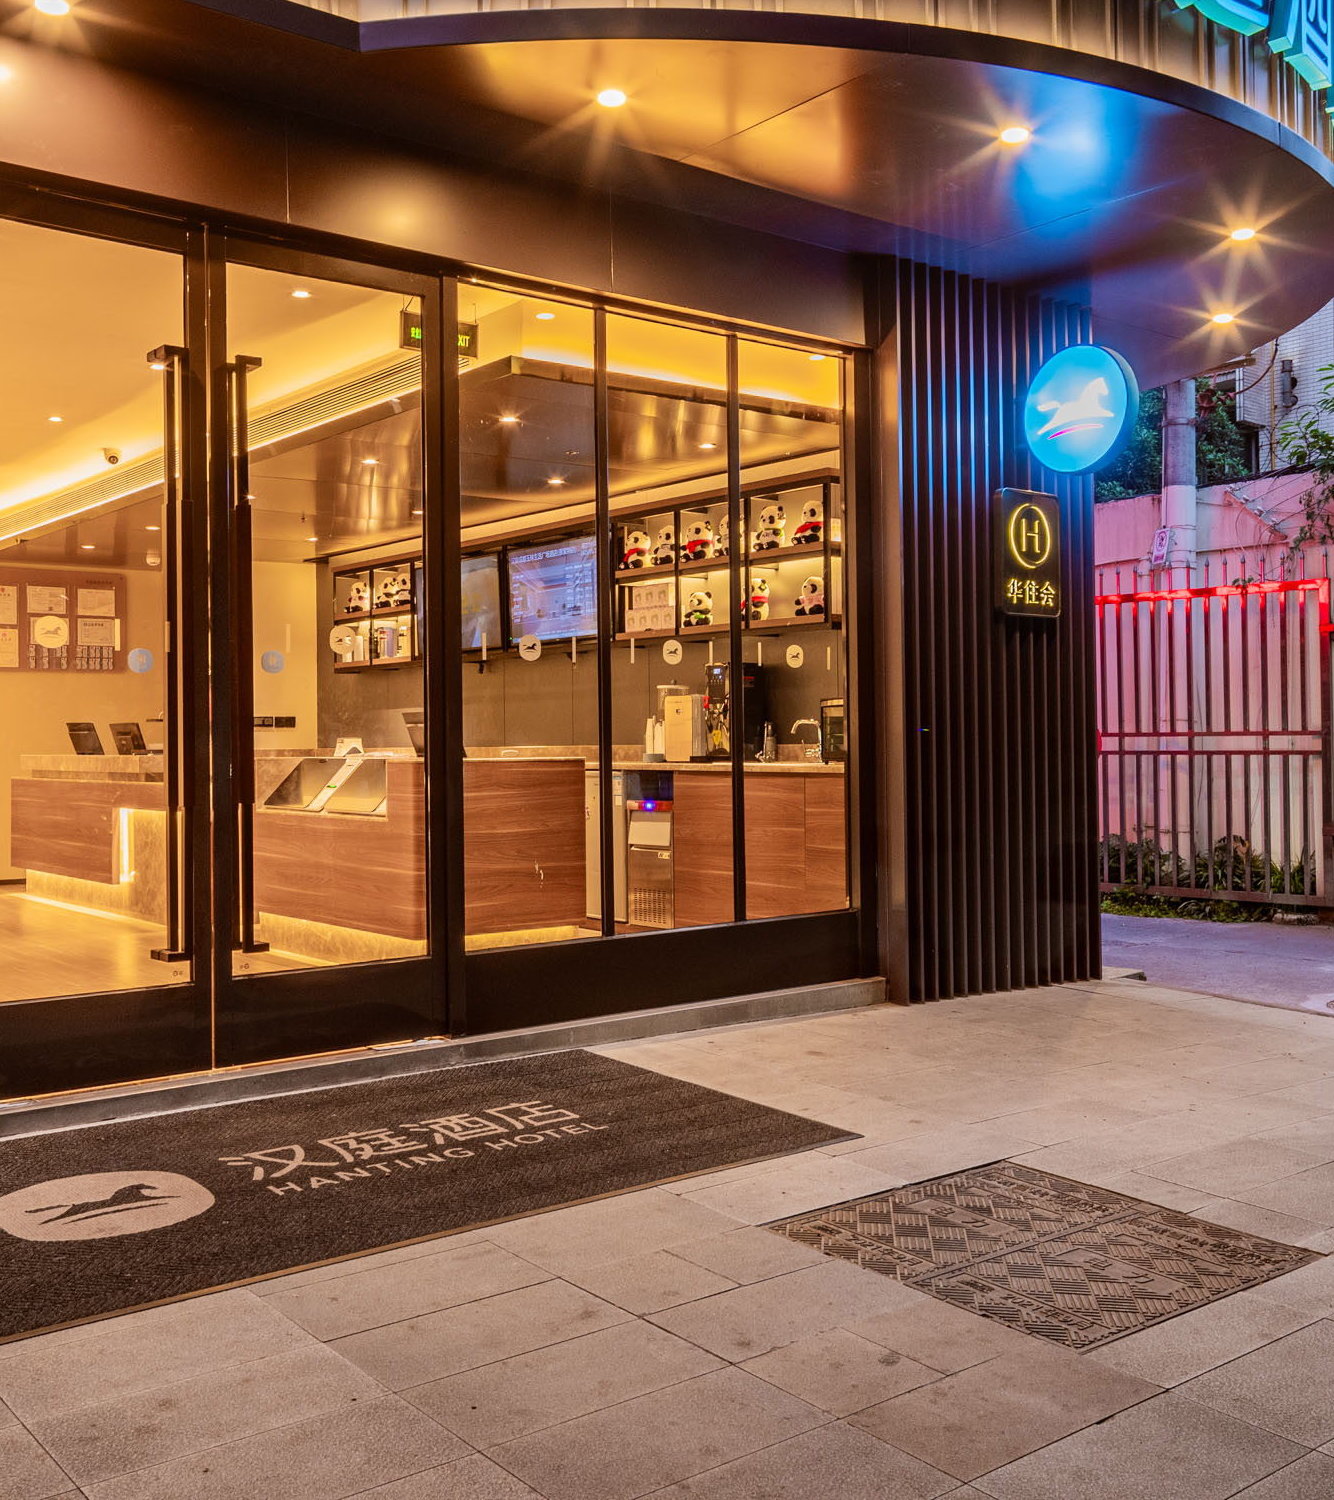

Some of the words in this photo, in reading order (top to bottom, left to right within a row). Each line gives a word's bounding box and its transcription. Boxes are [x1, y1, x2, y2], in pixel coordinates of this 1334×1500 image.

[1007, 579, 1056, 607] 华住会
[218, 1100, 580, 1182] 汉庭酒店
[267, 1146, 475, 1196] HANTING
[485, 1121, 609, 1151] HOTEL
